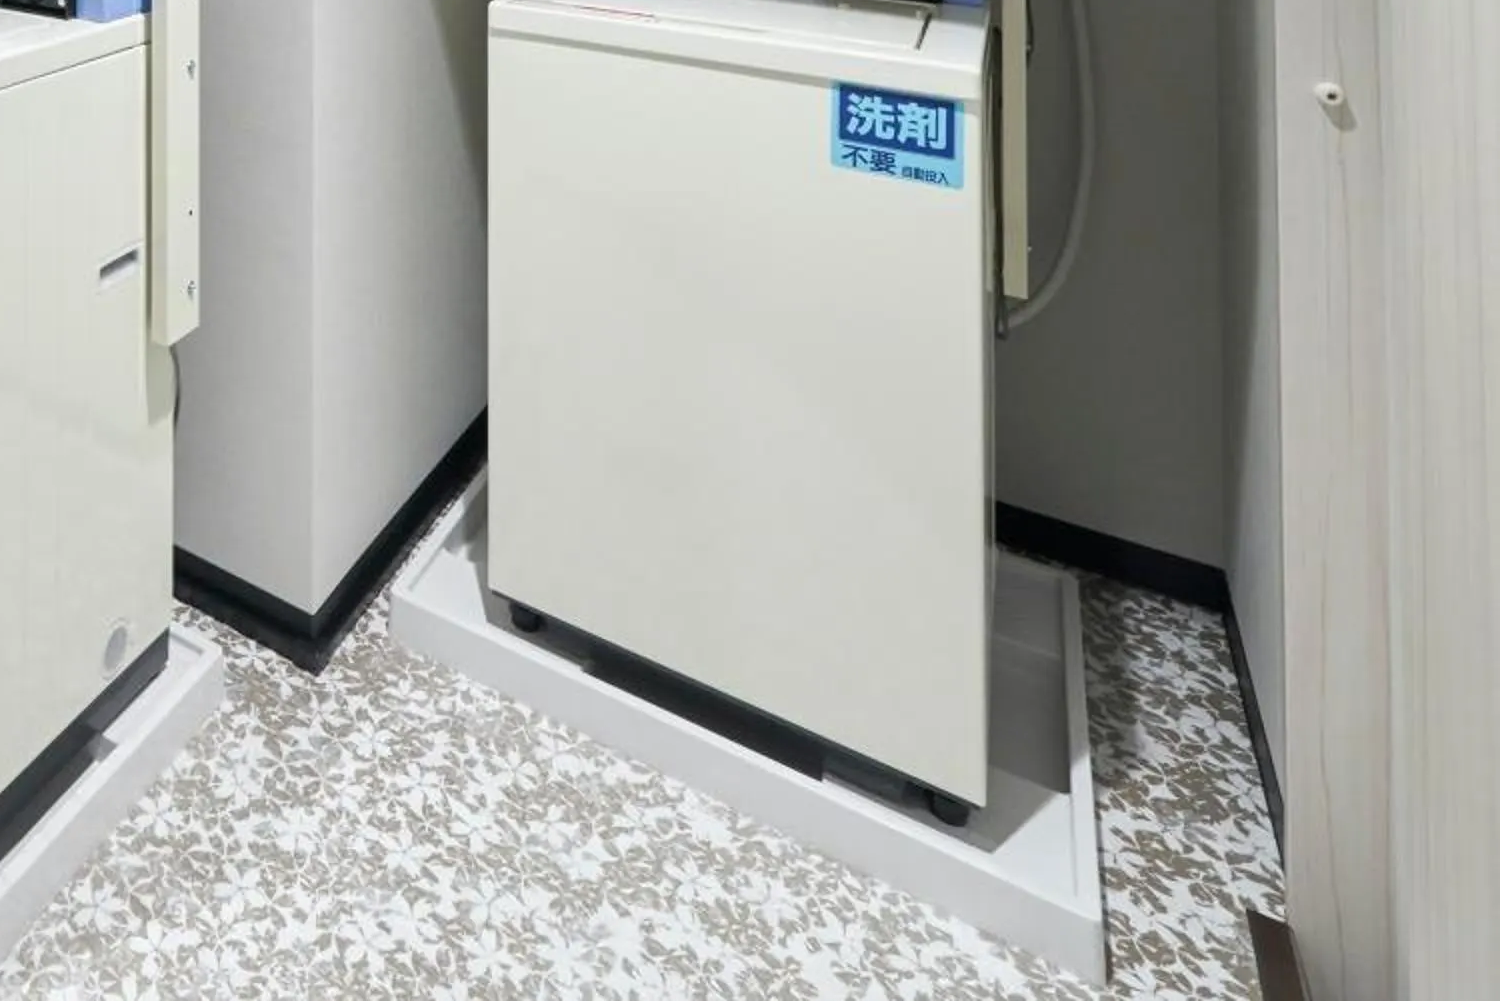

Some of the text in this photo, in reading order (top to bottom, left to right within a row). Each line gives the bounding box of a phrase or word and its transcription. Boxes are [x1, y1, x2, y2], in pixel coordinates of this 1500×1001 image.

[846, 92, 947, 150] 洗剤
[841, 145, 949, 186] 不要 自動投入
